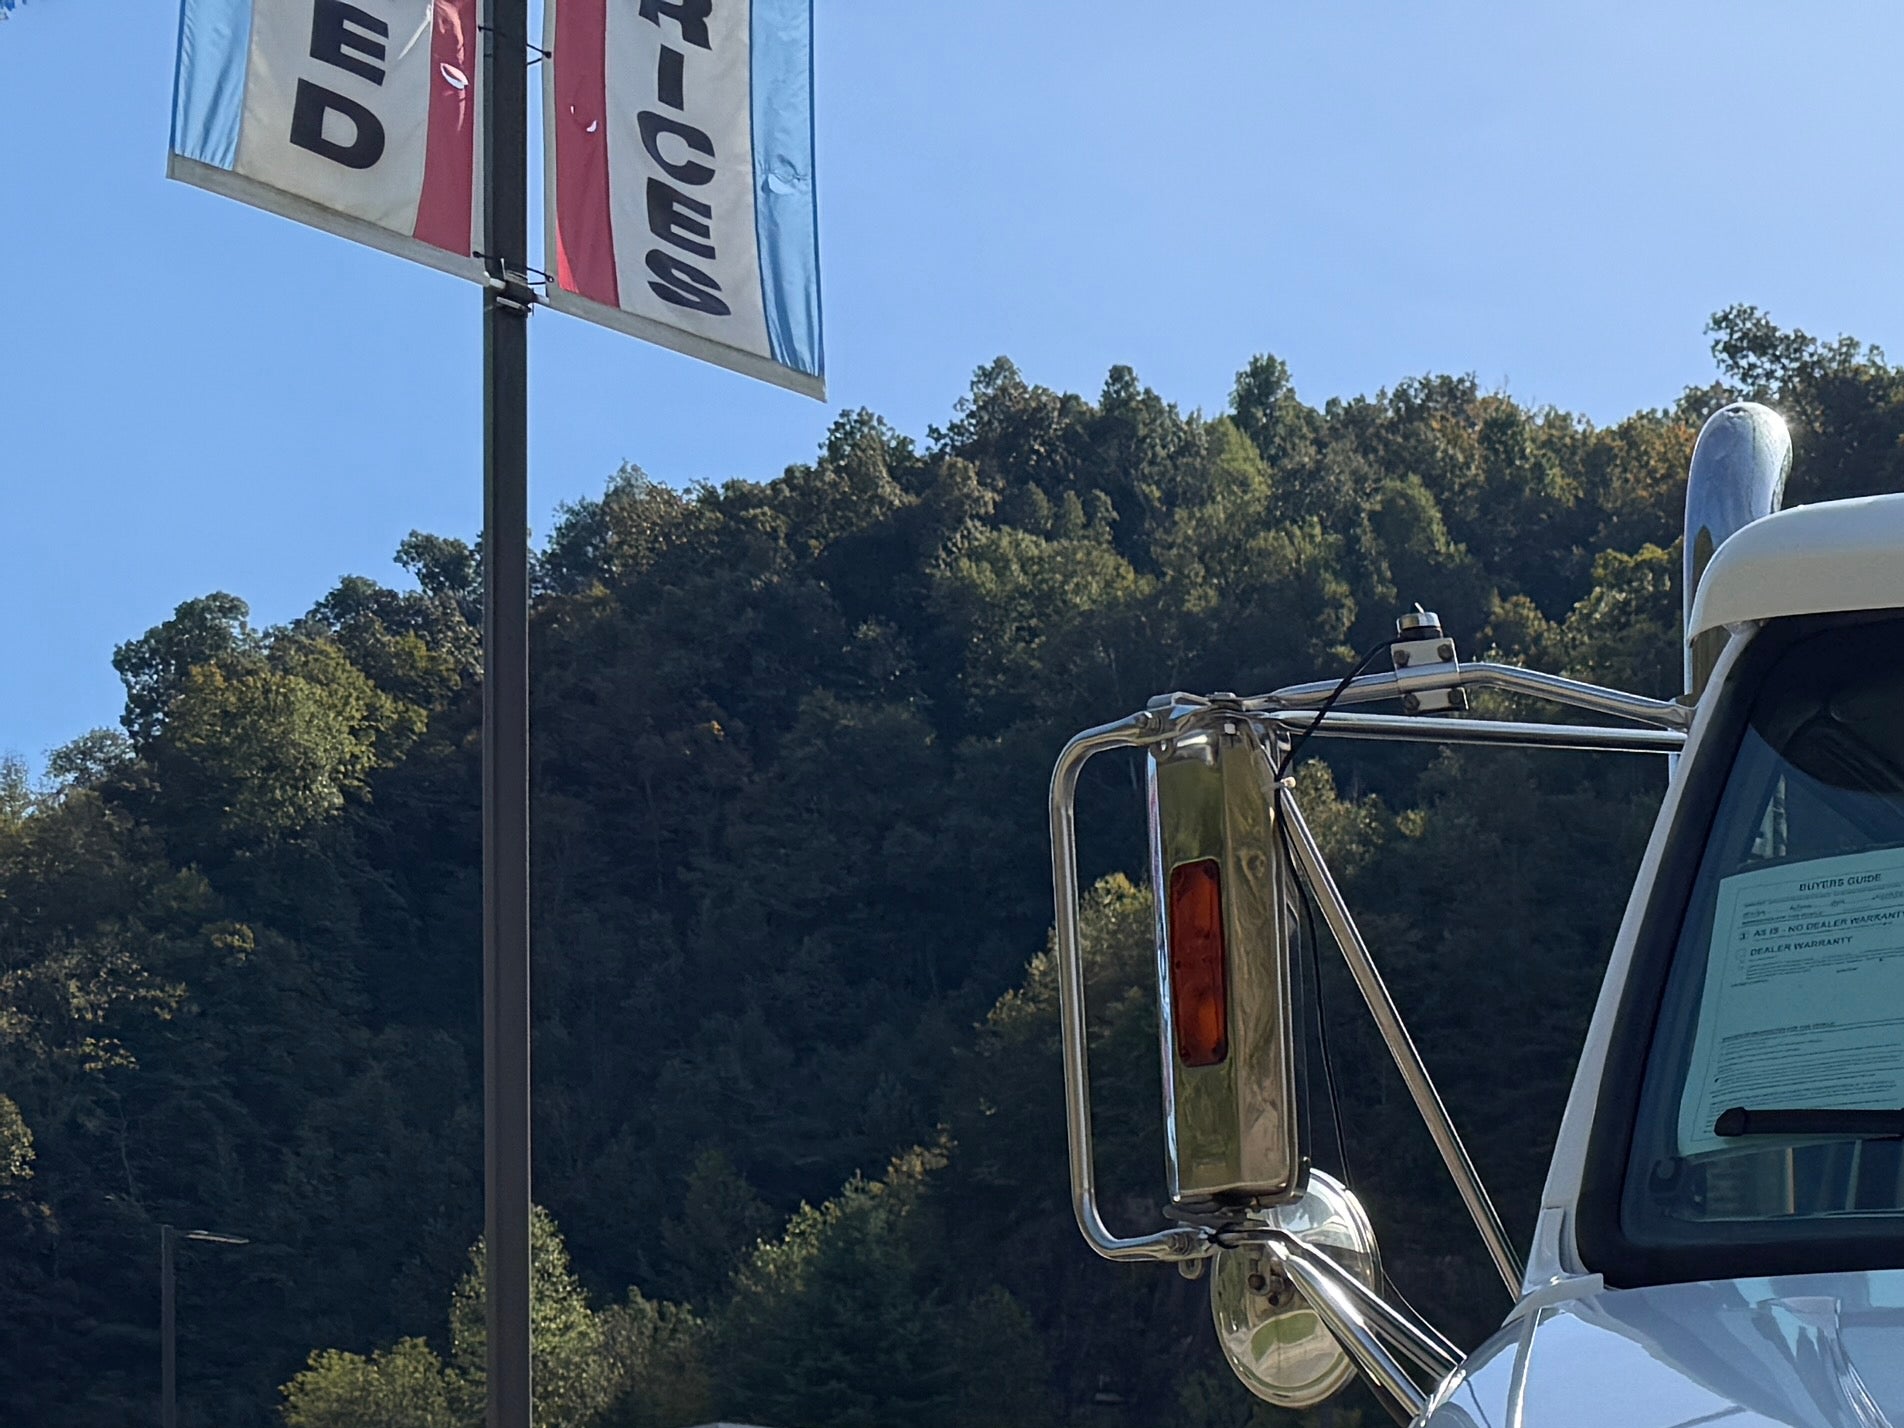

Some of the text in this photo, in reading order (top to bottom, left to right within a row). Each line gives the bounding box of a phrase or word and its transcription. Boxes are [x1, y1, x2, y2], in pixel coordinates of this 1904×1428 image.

[1799, 873, 1882, 892] BUYERS GUIDE
[1788, 923, 1804, 933] NO
[1806, 918, 1847, 931] DEALER
[1750, 936, 1853, 957] DEALER WARRANTY
